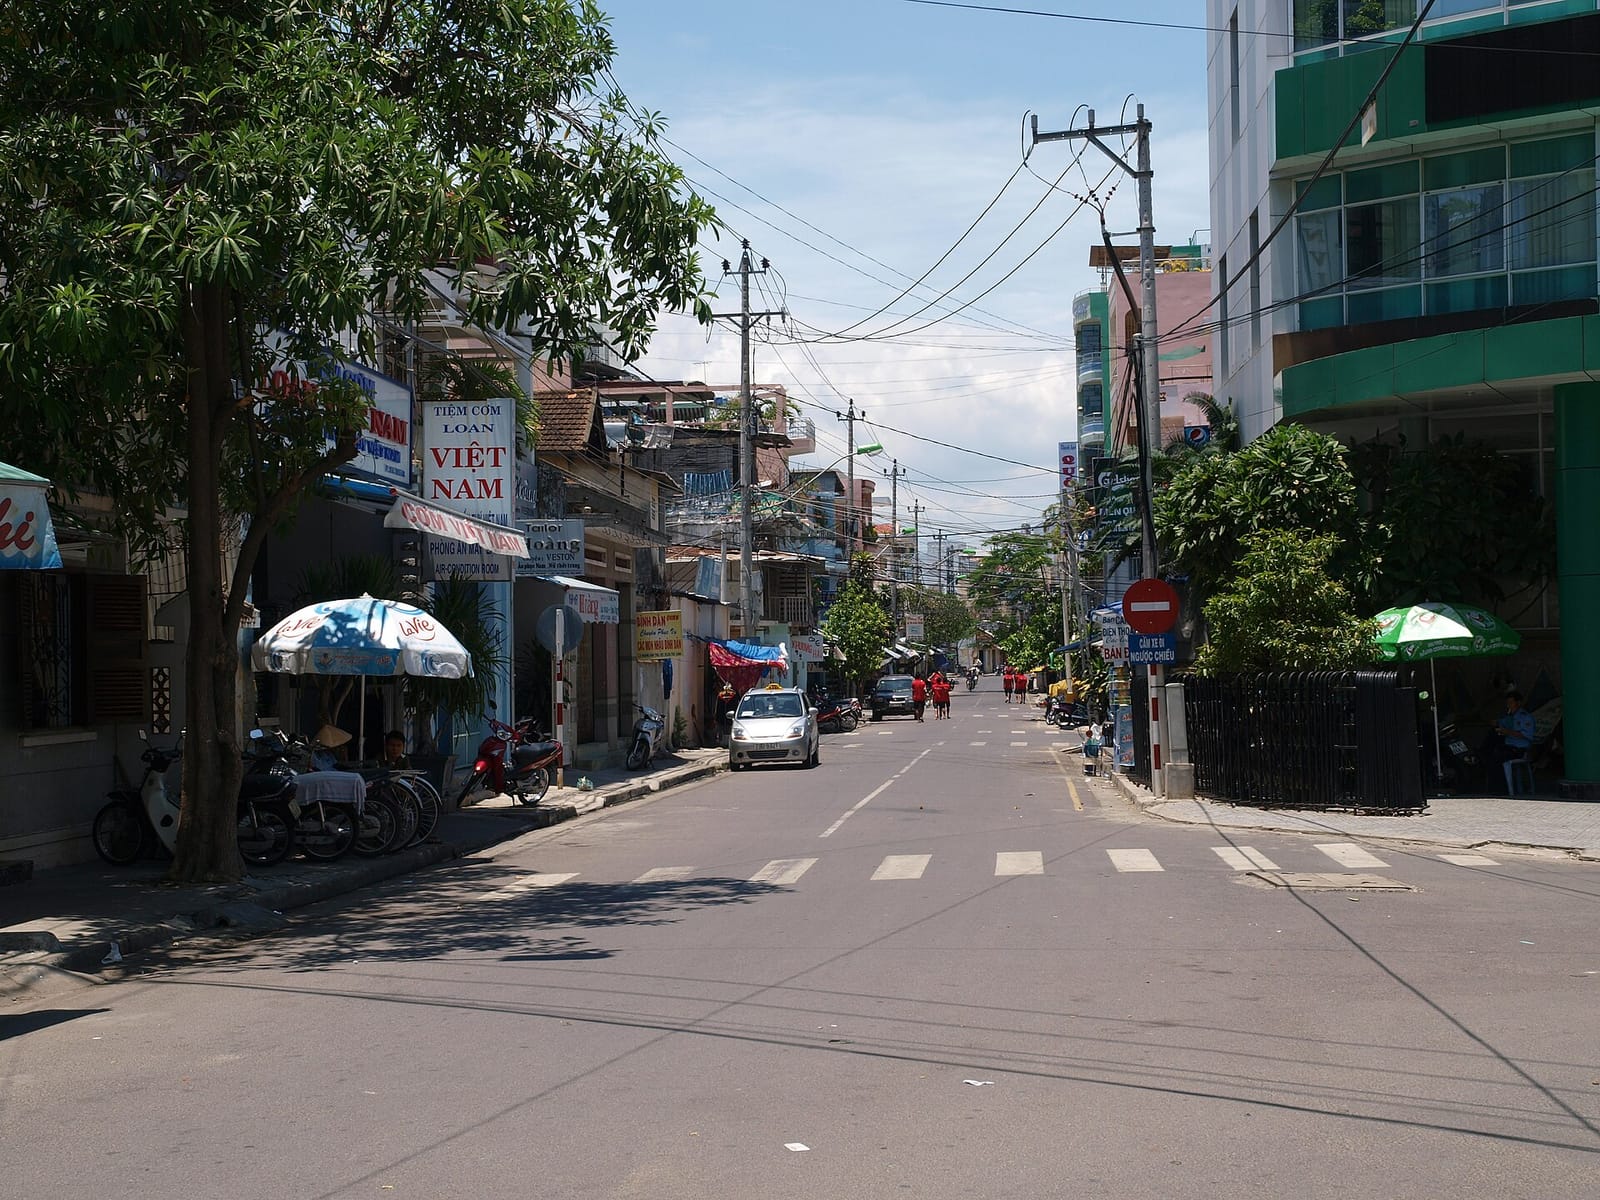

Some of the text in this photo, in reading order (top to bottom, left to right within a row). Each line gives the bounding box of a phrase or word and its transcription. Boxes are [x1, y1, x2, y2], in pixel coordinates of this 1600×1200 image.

[434, 404, 501, 418] TIỆM CƠM
[369, 407, 408, 446] NAM
[443, 424, 494, 433] LOAN
[430, 441, 506, 473] VIỆT
[431, 478, 504, 500] NAM
[401, 502, 448, 532] CƠM
[487, 529, 523, 554] NAM
[526, 523, 563, 533] Tailor
[546, 553, 575, 562] VESTON
[481, 563, 499, 574] ROOM
[1118, 626, 1133, 636] THO
[1104, 645, 1122, 659] BÁN
